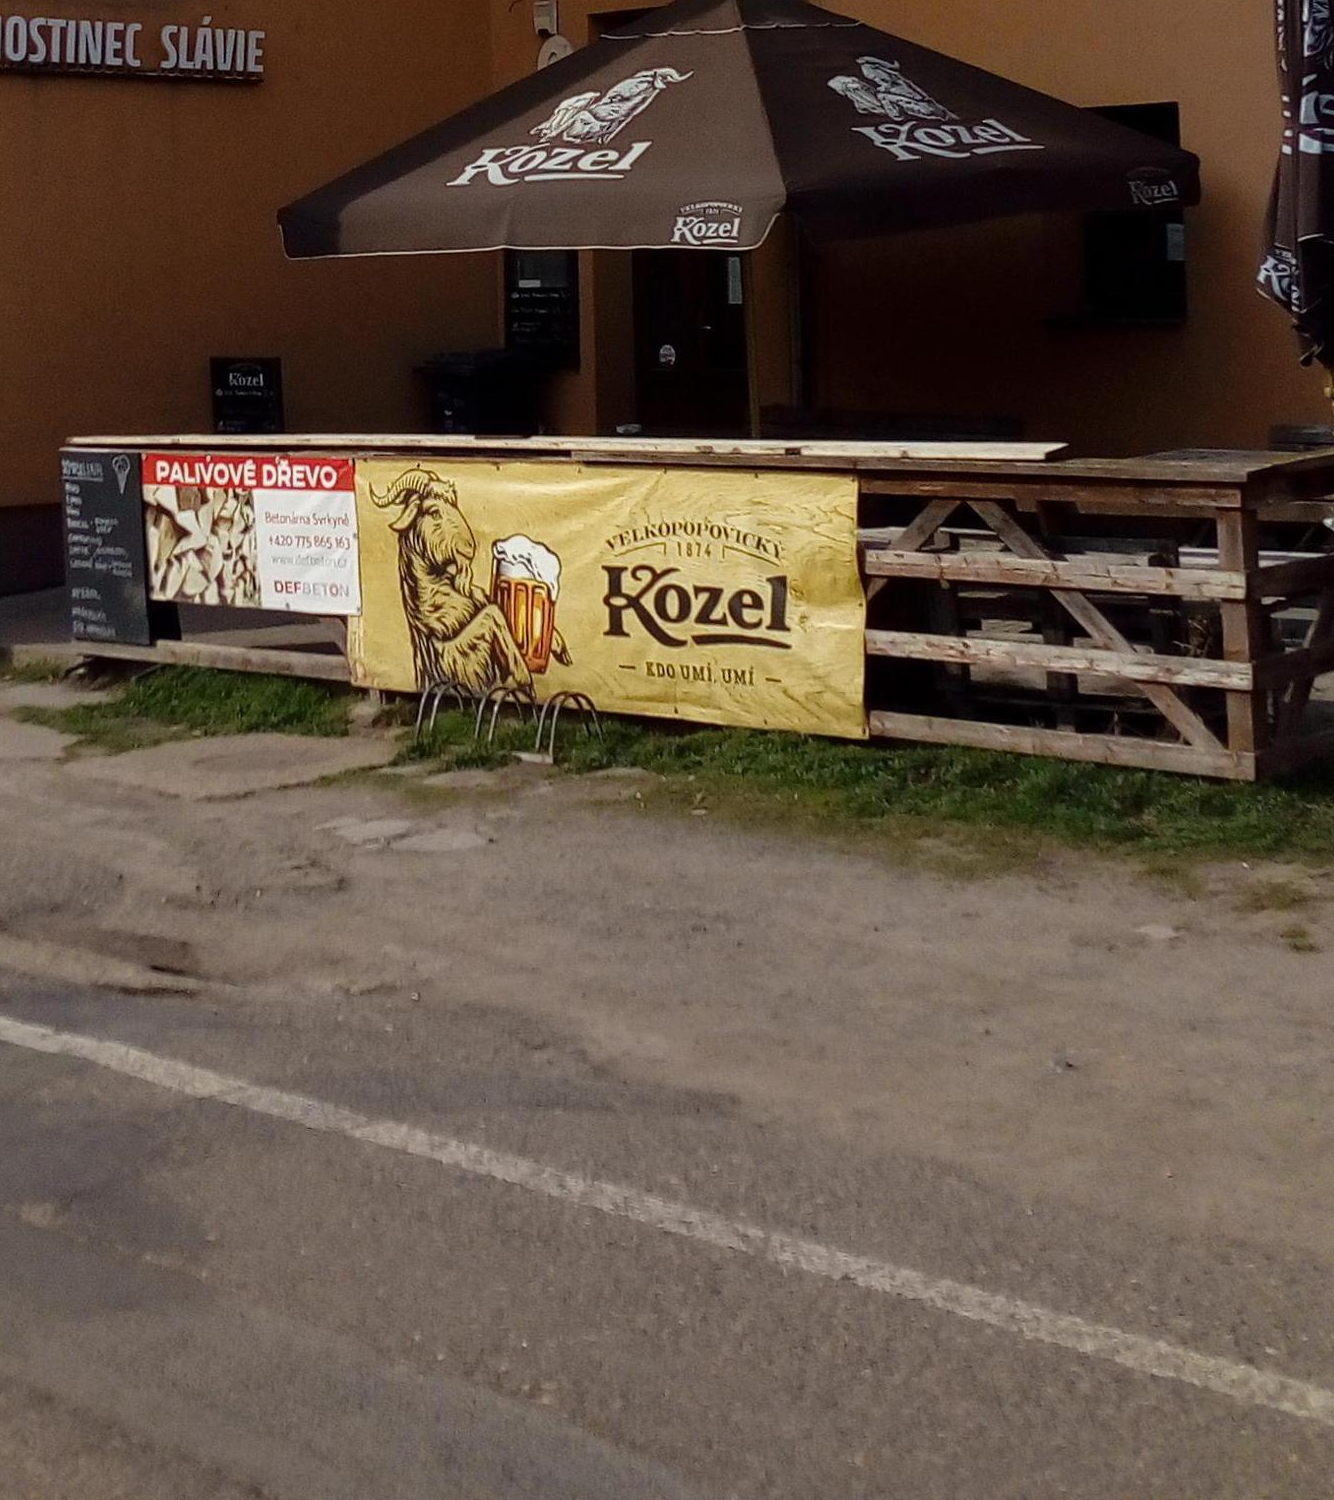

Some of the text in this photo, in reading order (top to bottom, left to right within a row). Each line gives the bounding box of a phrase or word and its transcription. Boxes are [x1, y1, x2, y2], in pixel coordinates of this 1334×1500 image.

[160, 15, 265, 73] SLÁVIE
[850, 118, 1039, 161] Kozel
[446, 141, 652, 186] Kozel
[1128, 180, 1179, 205] Kozel
[670, 216, 741, 245] Kozel
[228, 372, 265, 388] Kozel
[156, 459, 338, 489] PALIVOVÉ DŘEVO
[269, 534, 293, 546] +420
[294, 535, 312, 548] 775
[677, 541, 712, 557] 1874
[274, 580, 349, 597] DEFBETON
[601, 564, 791, 647] Kozel
[645, 662, 675, 679] KDO
[721, 666, 755, 686] UMÍ
